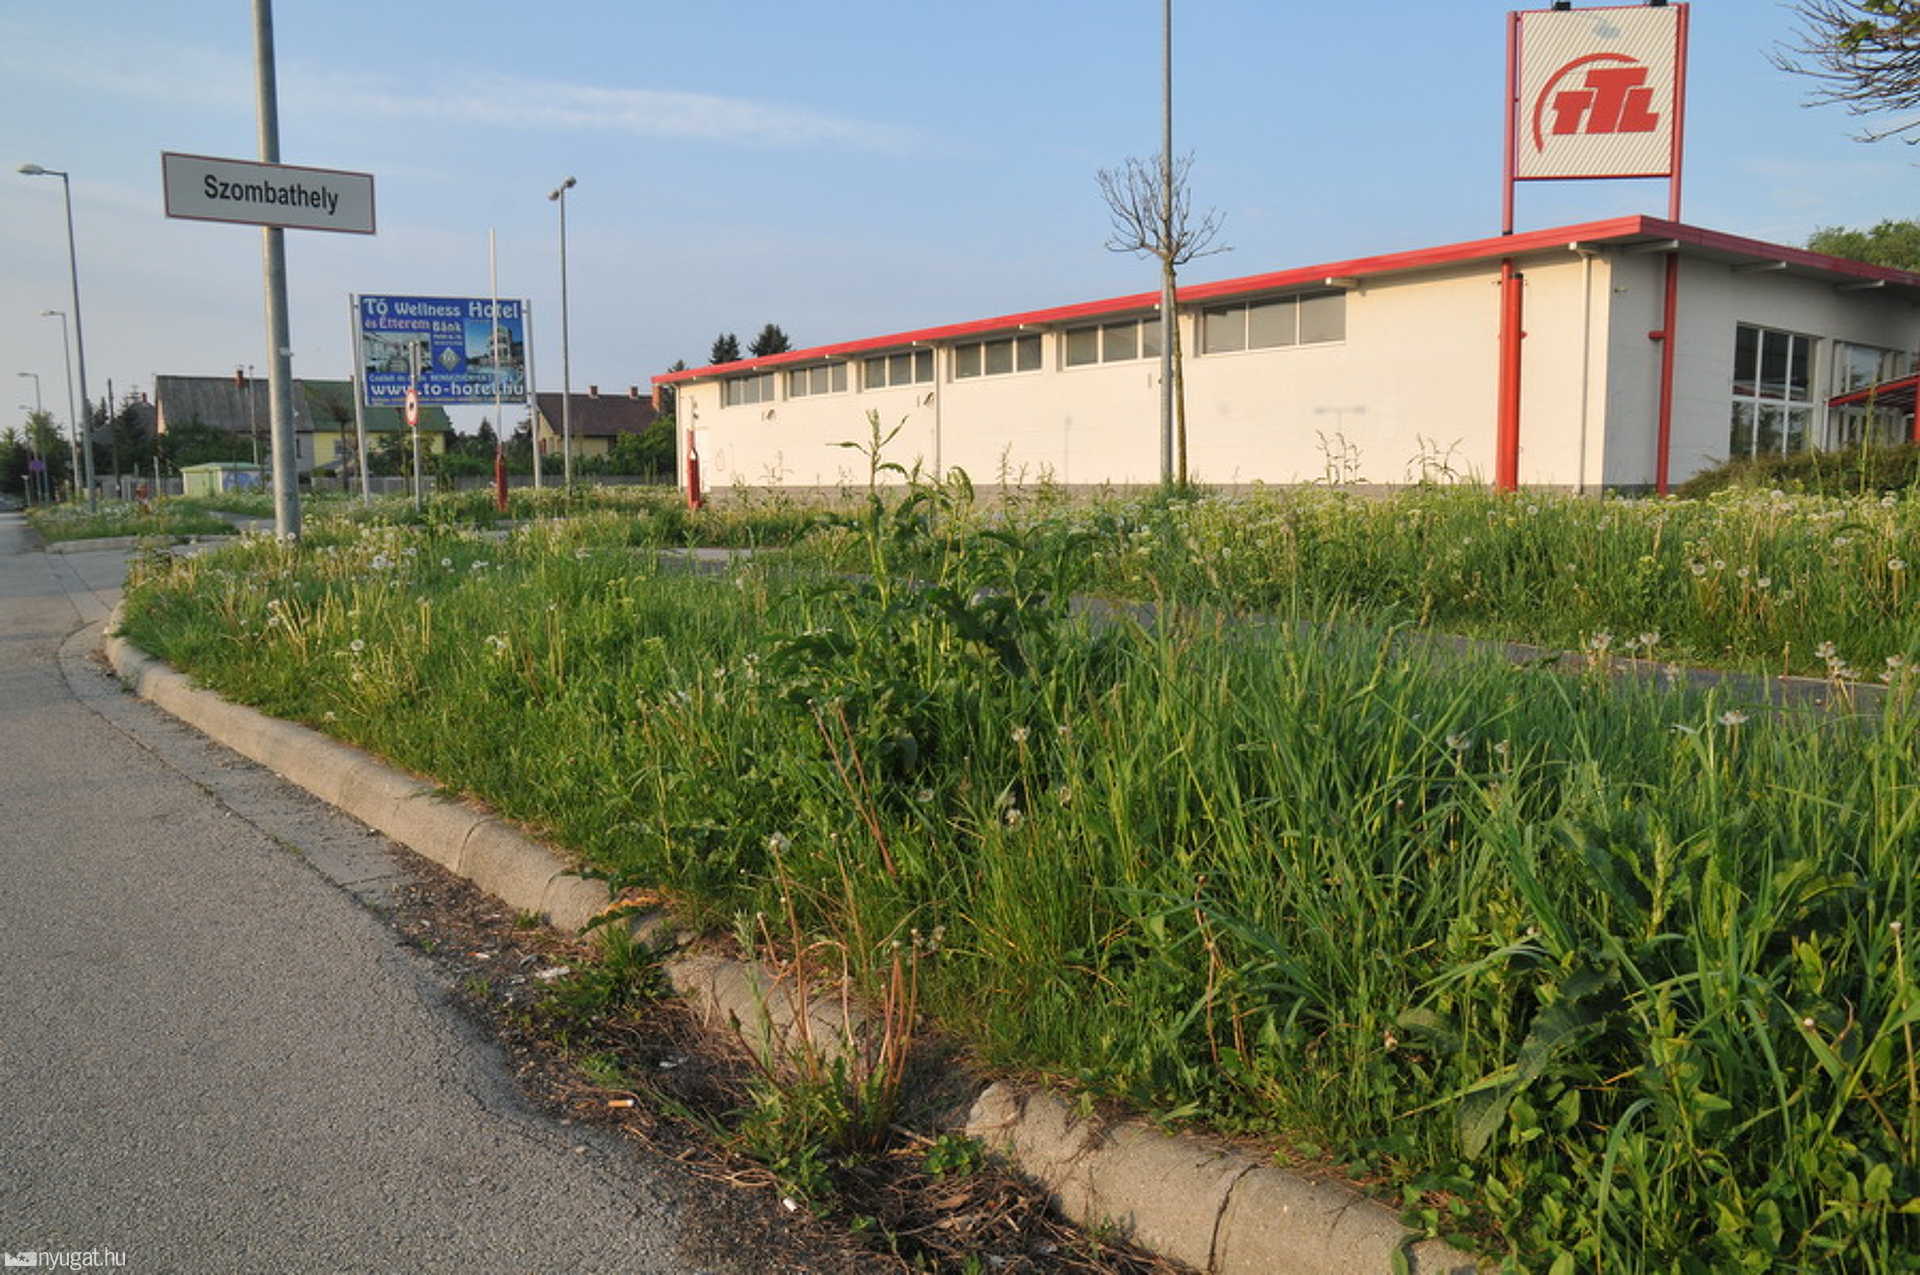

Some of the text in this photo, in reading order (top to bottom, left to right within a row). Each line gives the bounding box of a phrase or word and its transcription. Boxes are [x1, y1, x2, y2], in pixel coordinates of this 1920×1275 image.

[203, 173, 339, 216] Szombathely
[362, 298, 519, 319] Tó Wellness Hotel
